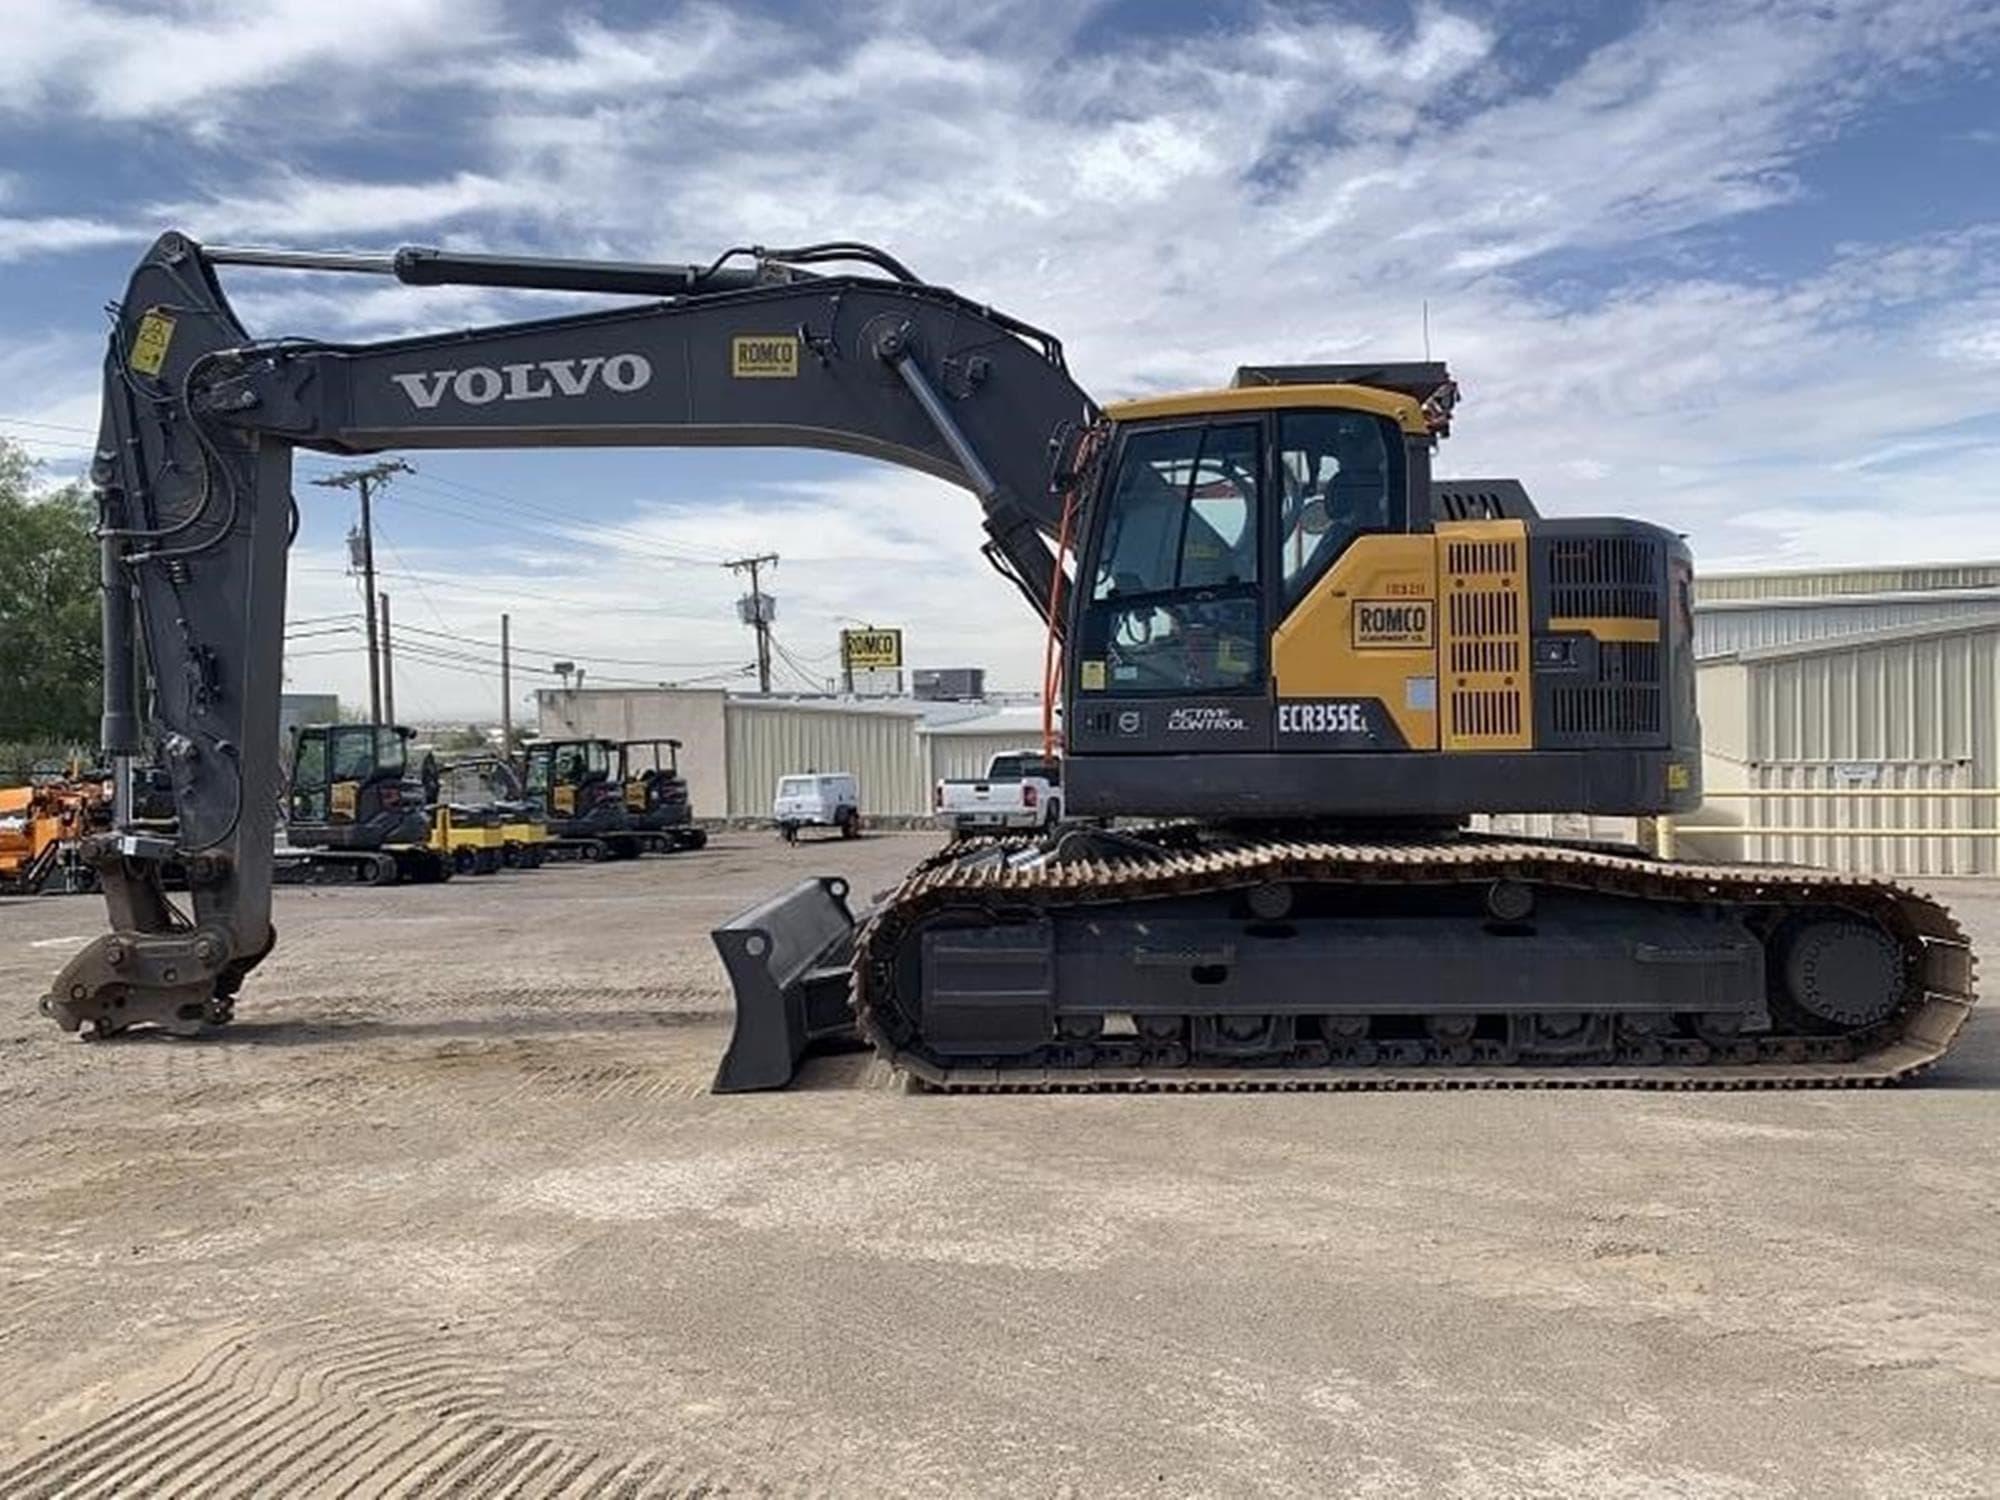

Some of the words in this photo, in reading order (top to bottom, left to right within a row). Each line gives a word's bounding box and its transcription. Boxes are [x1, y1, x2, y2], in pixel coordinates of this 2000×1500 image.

[740, 342, 792, 363] ROMCO
[392, 354, 651, 407] VOLVO
[1360, 607, 1426, 632] ROMCO
[1168, 718, 1249, 731] CONTROL
